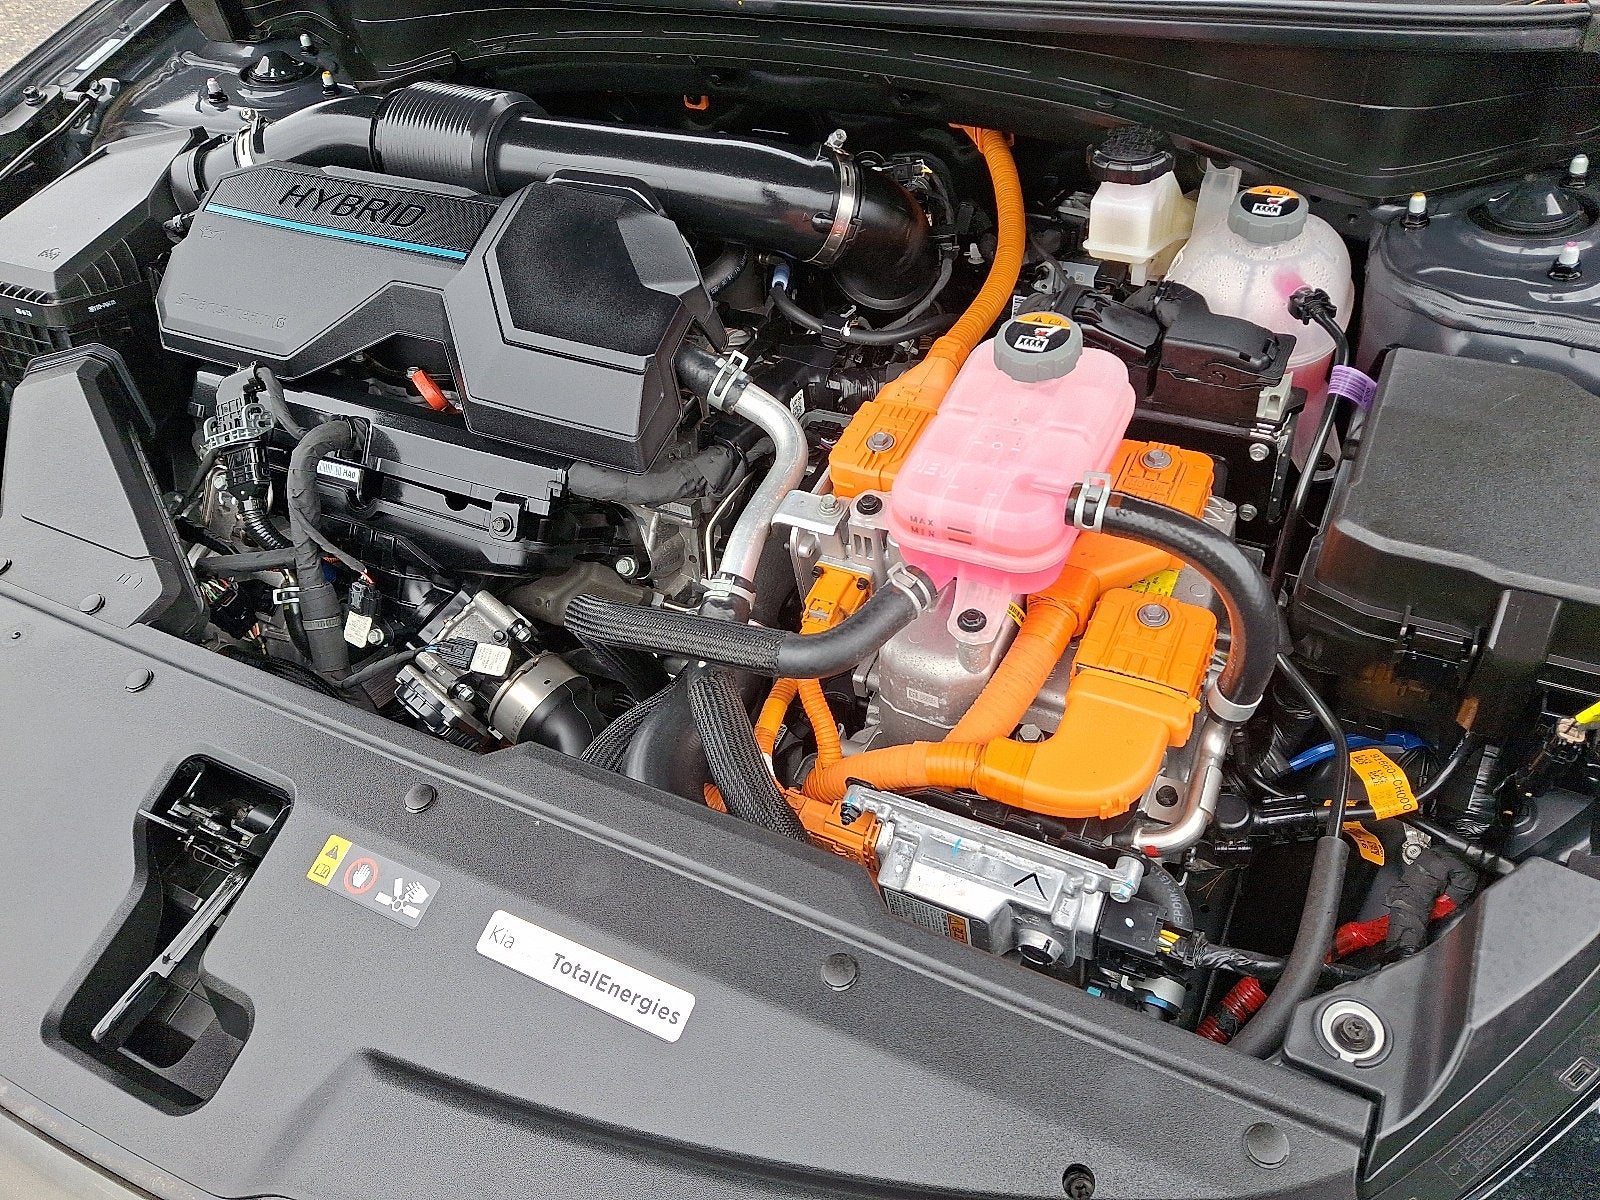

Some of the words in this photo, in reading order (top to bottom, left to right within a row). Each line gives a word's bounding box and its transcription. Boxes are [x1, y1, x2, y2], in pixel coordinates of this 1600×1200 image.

[278, 184, 427, 228] HYBRID
[910, 515, 934, 527] MAX
[910, 525, 935, 538] MIN
[489, 924, 515, 950] Kia
[552, 952, 681, 1025] TotalEnergies
